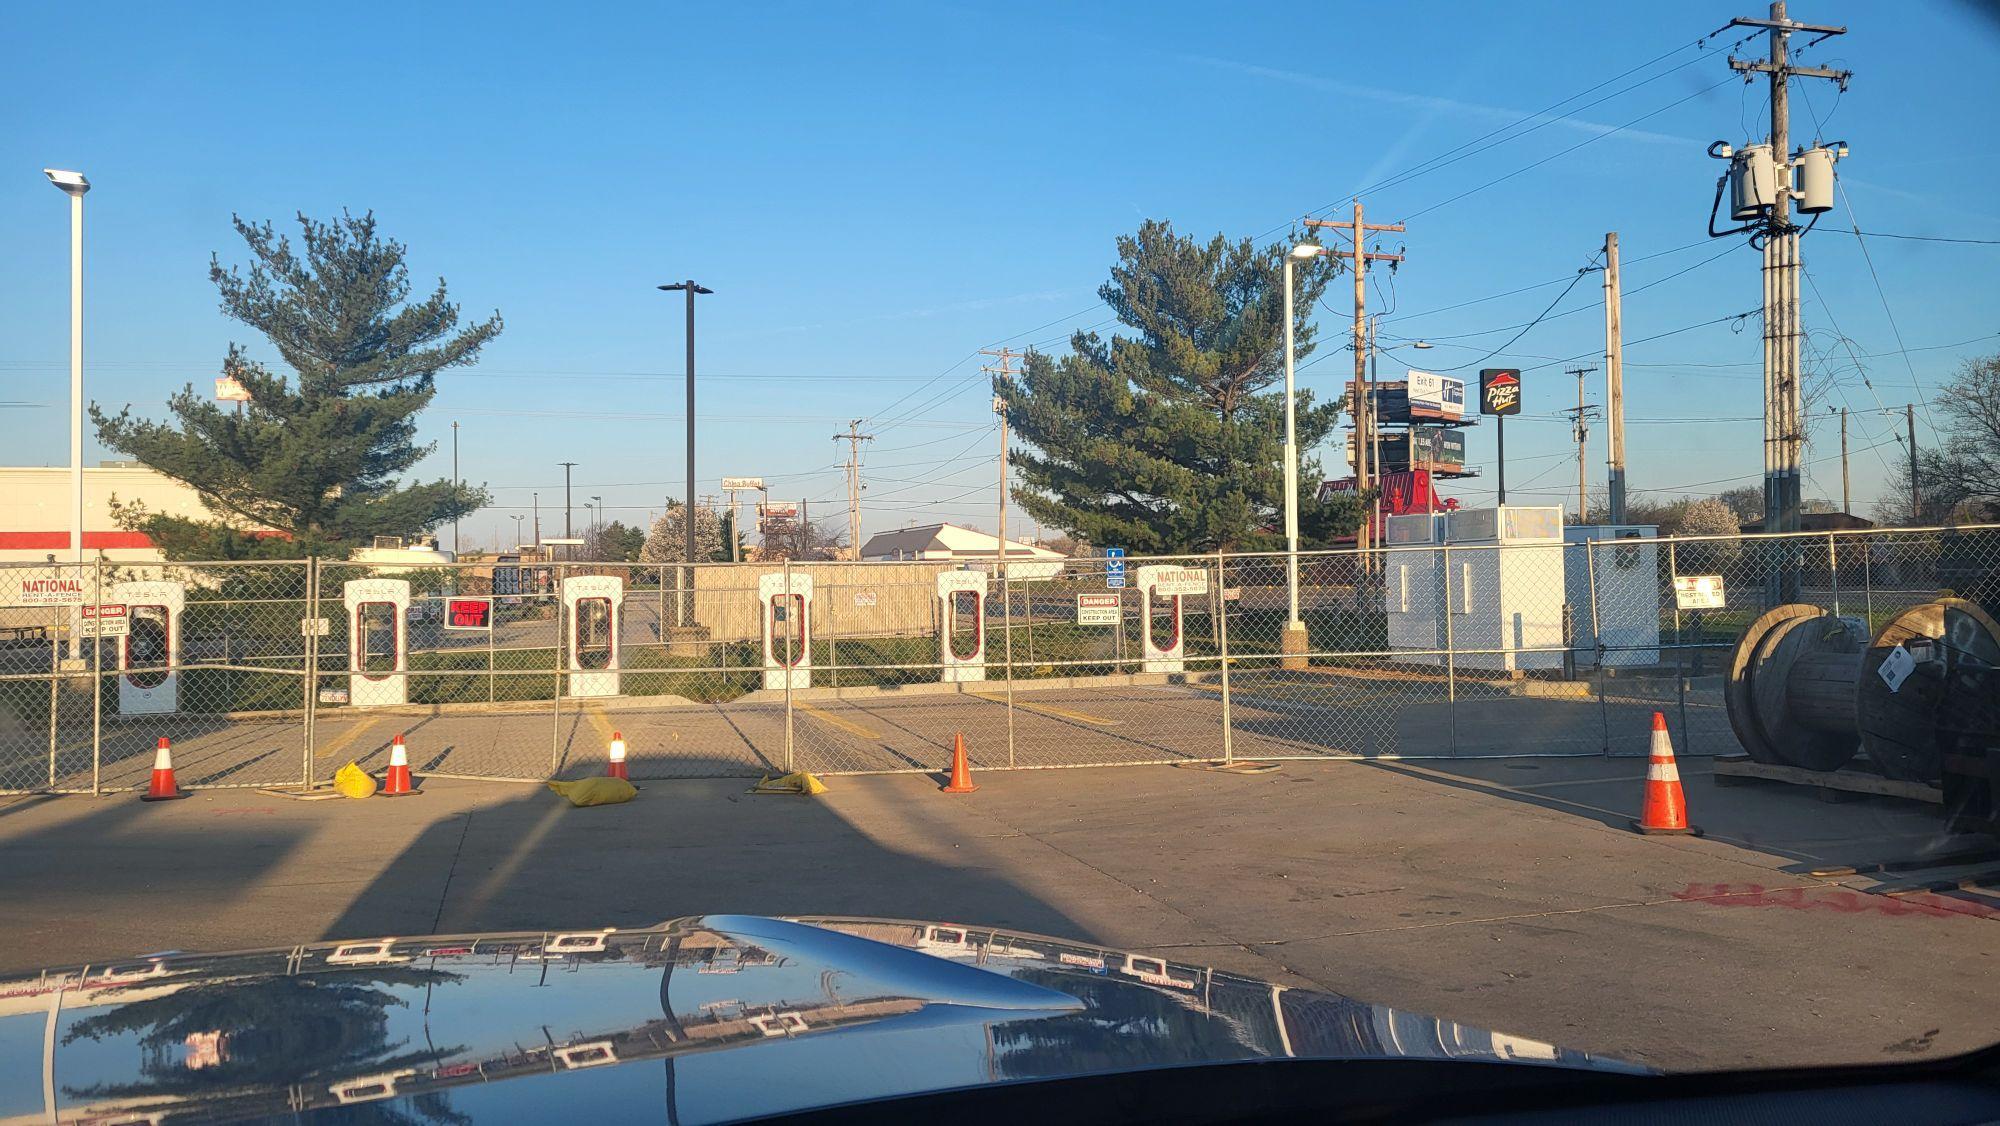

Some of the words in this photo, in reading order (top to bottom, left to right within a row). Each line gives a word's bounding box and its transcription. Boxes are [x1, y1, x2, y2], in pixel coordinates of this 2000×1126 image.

[1487, 384, 1519, 402] Pizza
[1492, 394, 1516, 407] Hut
[1157, 571, 1206, 582] NATIONAL
[23, 580, 82, 593] NATIONAL
[451, 601, 488, 614] KEEP
[454, 613, 484, 626] OUT
